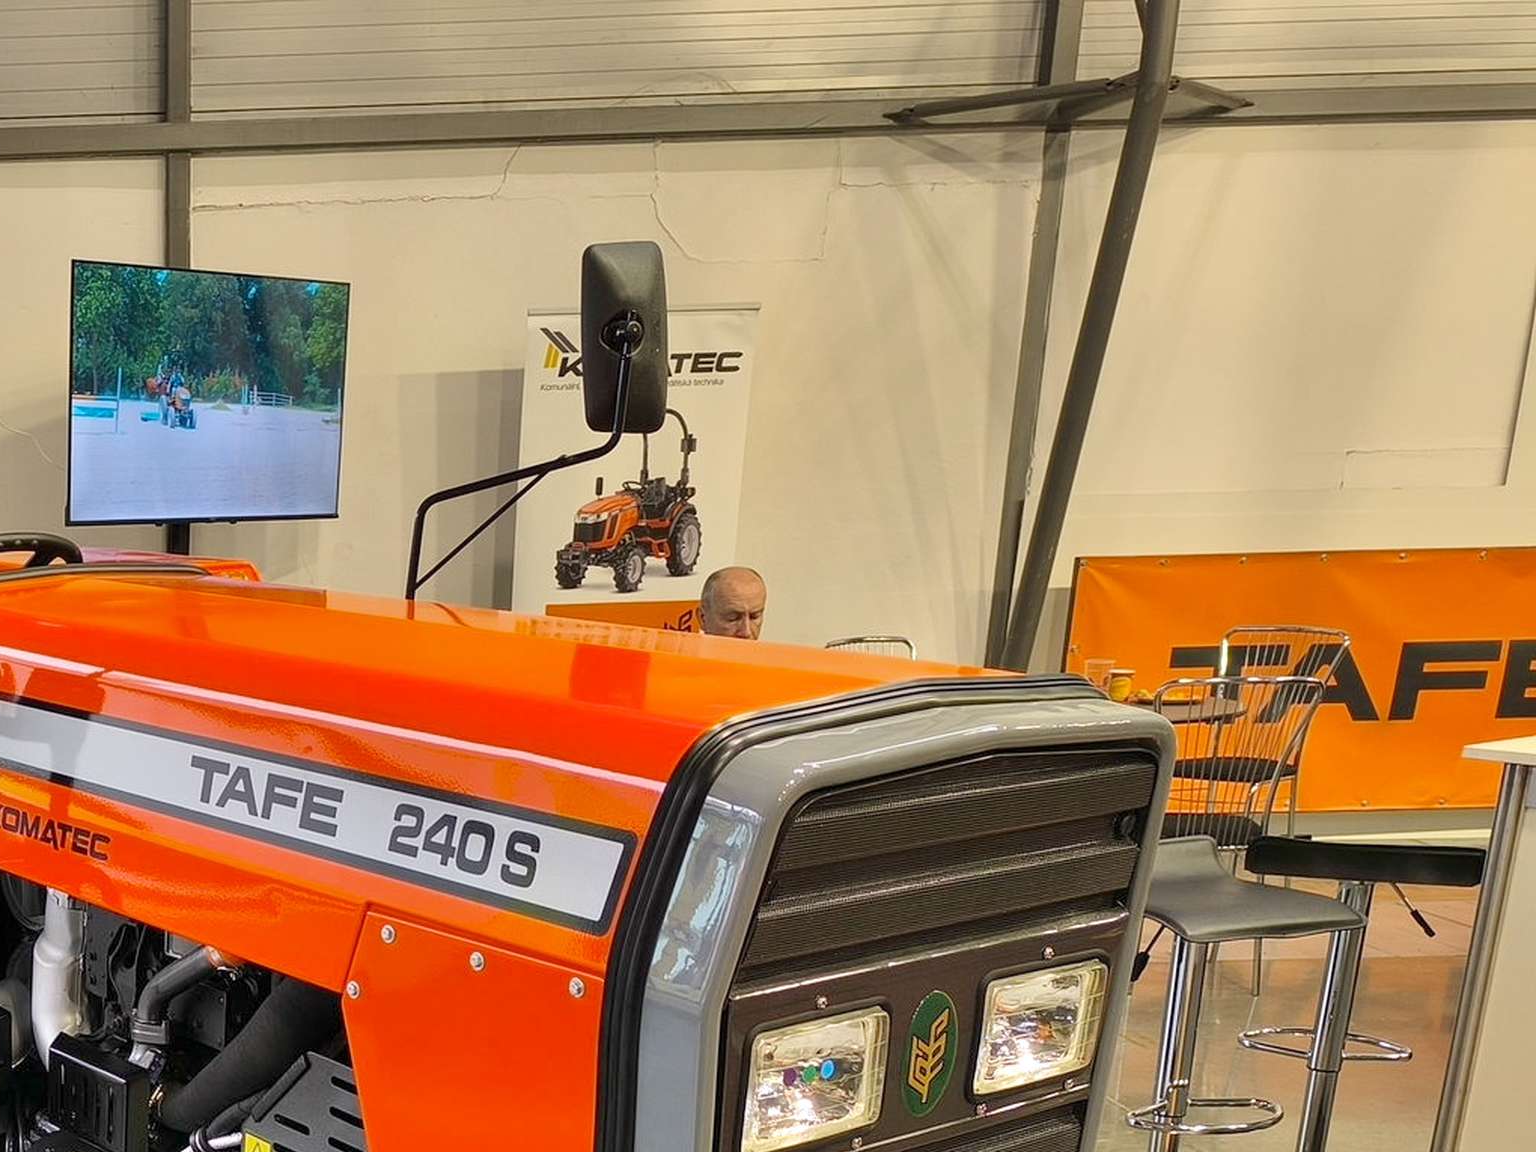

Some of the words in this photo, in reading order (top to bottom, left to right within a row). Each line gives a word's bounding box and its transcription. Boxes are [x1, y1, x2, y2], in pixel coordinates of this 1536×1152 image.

[558, 352, 743, 377] KTEC
[191, 755, 344, 837] TAFE
[388, 803, 495, 875] 240
[500, 830, 541, 888] S
